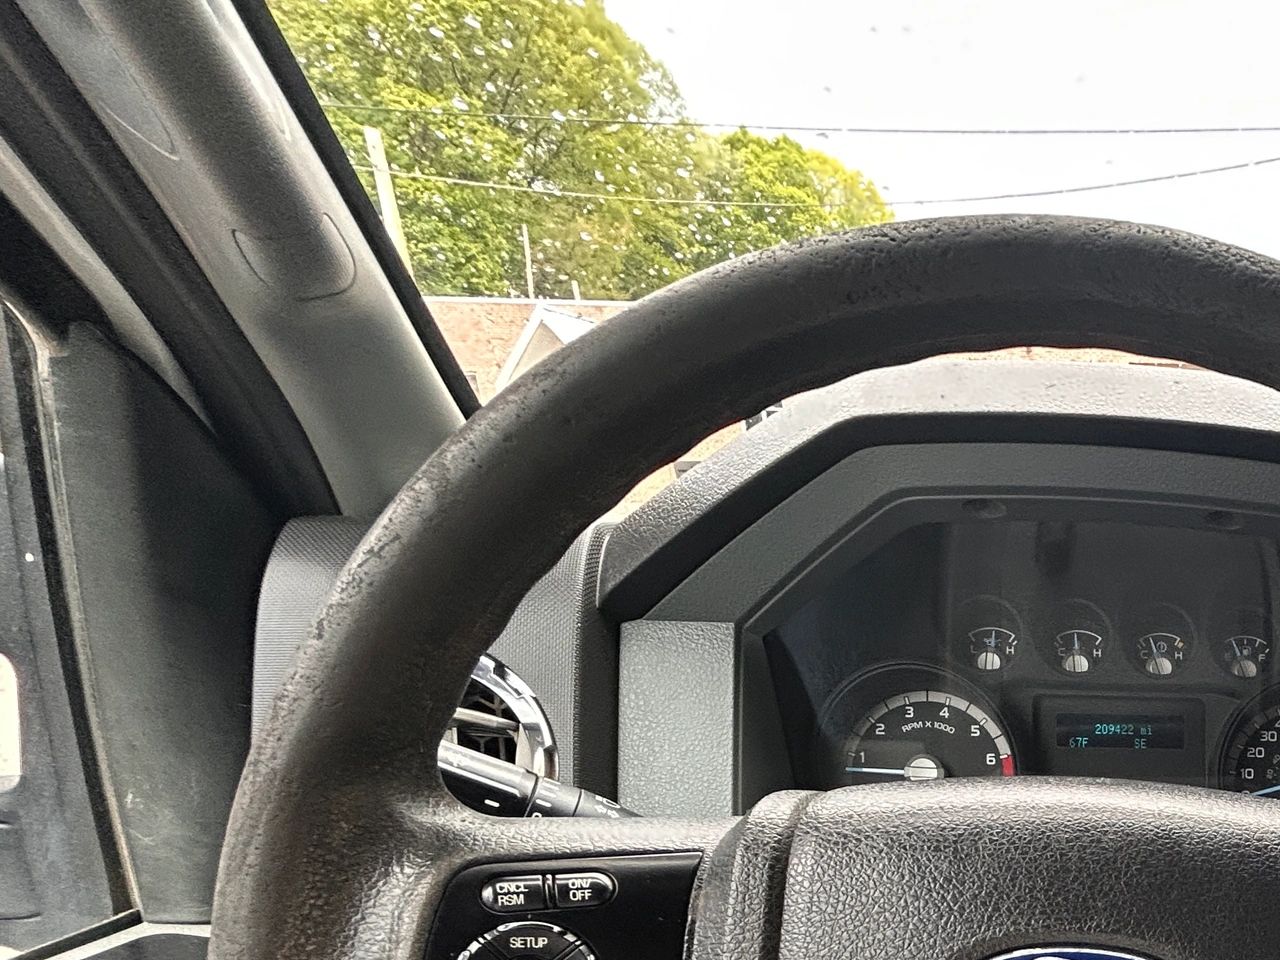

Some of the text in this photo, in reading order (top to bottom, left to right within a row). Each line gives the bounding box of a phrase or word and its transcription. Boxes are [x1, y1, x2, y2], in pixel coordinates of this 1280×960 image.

[1007, 646, 1014, 654] H
[1093, 649, 1101, 657] H
[1175, 652, 1182, 660] H
[1258, 654, 1266, 662] F
[905, 707, 914, 718] 3
[939, 707, 949, 718] 4
[875, 724, 885, 735] 2
[902, 720, 923, 733] RPM
[934, 721, 955, 734] 1000
[970, 725, 980, 737] 5
[1094, 724, 1152, 735] 209422 mi
[1260, 731, 1277, 742] 30
[1134, 738, 1147, 749] SE
[859, 752, 865, 763] 1
[1247, 747, 1265, 758] 20
[986, 753, 996, 765] 6
[1240, 768, 1254, 779] 10
[496, 881, 529, 893] CNCL
[498, 894, 525, 906] RSM
[569, 889, 592, 901] OFF
[509, 936, 548, 949] SETUP
